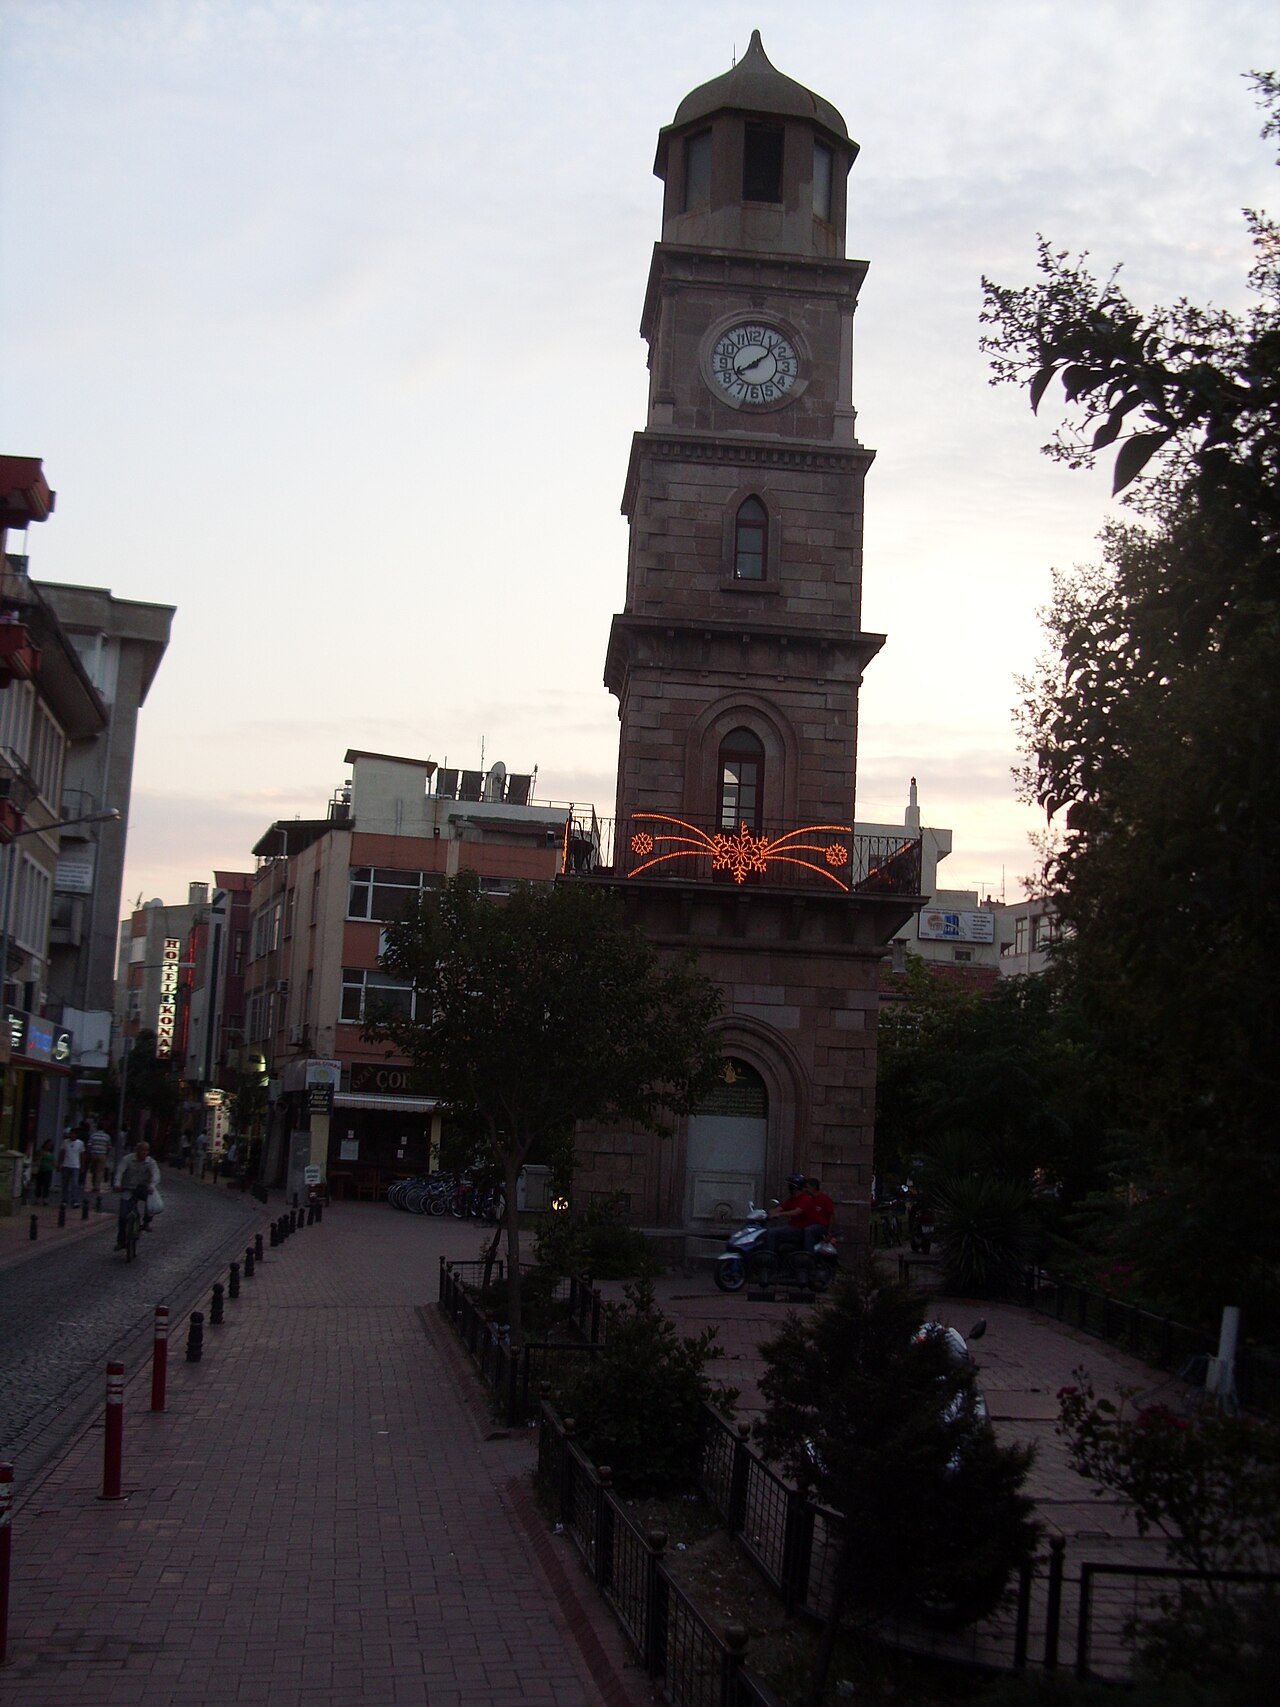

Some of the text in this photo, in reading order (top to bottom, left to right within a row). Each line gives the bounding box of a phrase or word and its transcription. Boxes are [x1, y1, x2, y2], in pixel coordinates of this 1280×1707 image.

[736, 333, 745, 345] 11
[749, 330, 762, 342] 12
[722, 343, 735, 355] 10
[777, 346, 787, 358] 2
[719, 357, 728, 369] 9
[781, 361, 790, 373] 3
[723, 372, 732, 384] 8
[777, 376, 786, 387] 4
[736, 383, 745, 395] 7
[750, 387, 759, 399] 6
[765, 385, 774, 397] 5
[158, 940, 178, 1057] HOTEL KONAK
